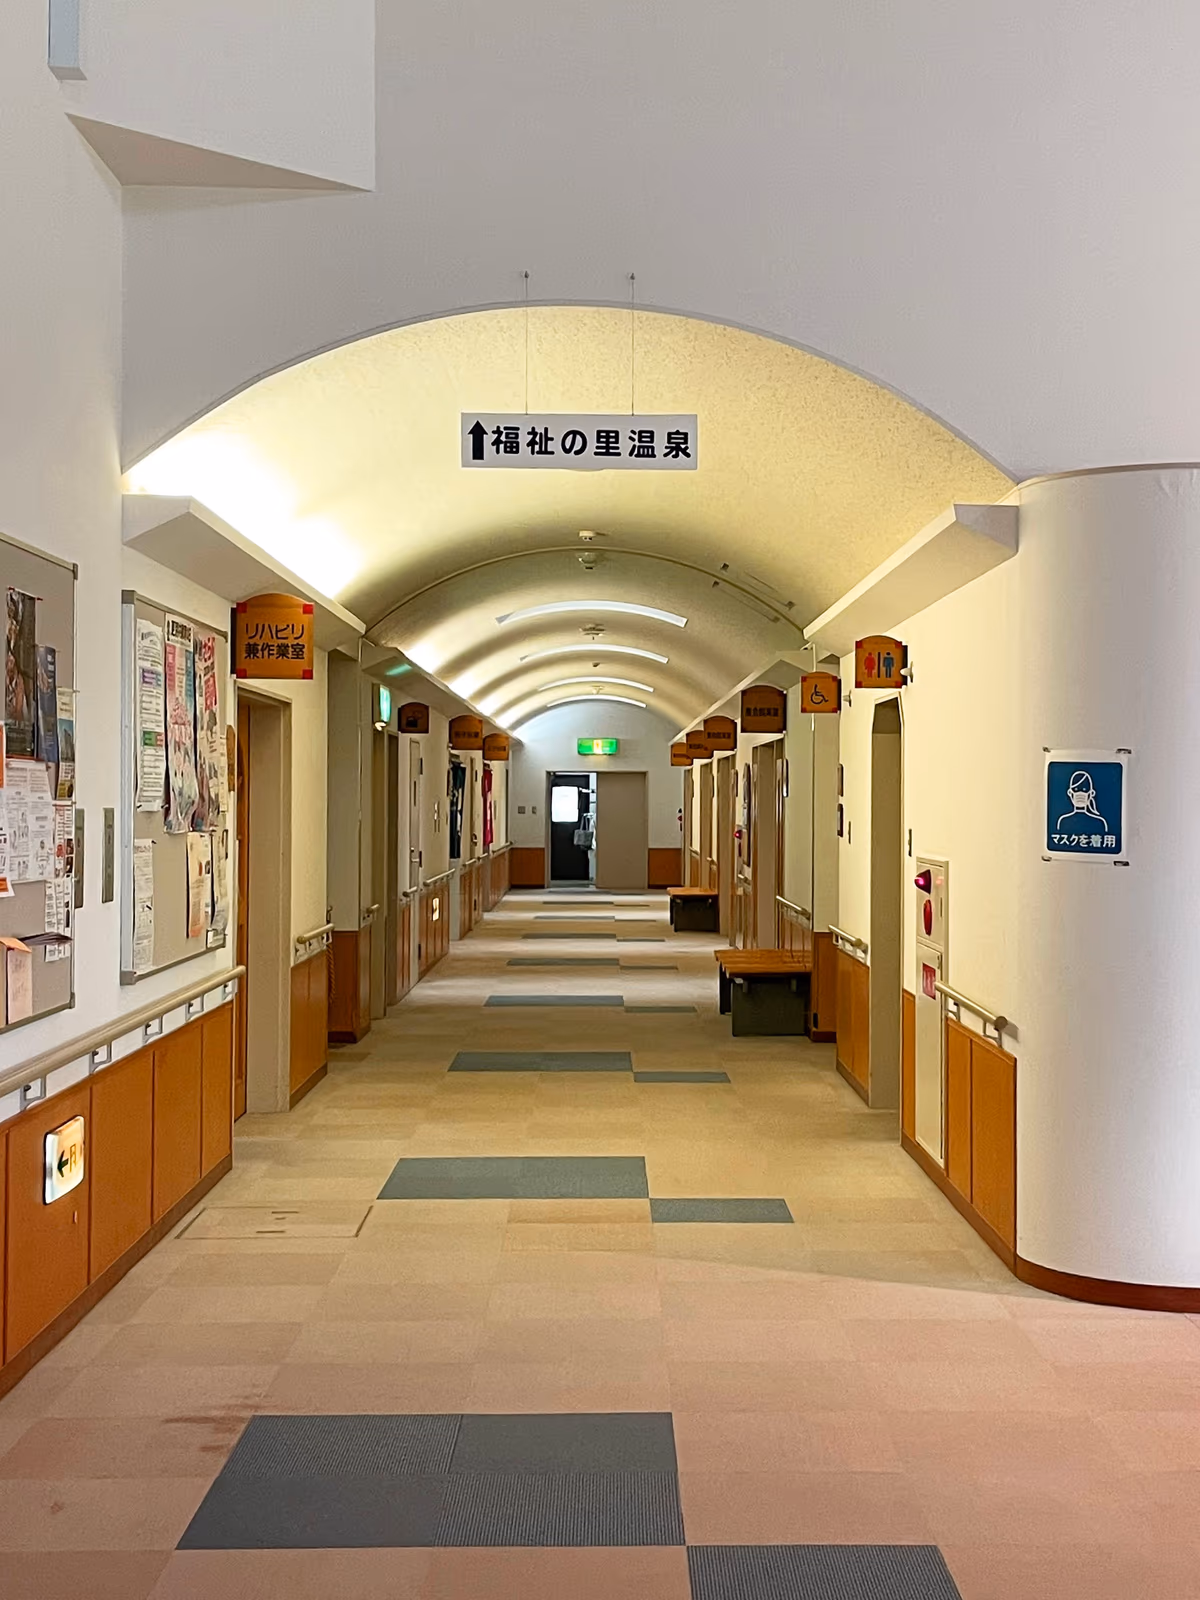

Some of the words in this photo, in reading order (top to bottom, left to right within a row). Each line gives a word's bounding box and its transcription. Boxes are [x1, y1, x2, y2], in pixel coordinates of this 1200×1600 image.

[491, 425, 692, 459] 福祉の里温泉
[245, 623, 305, 640] リハビリ
[244, 642, 306, 660] 兼作業室
[1051, 834, 1116, 848] マスクを着用
